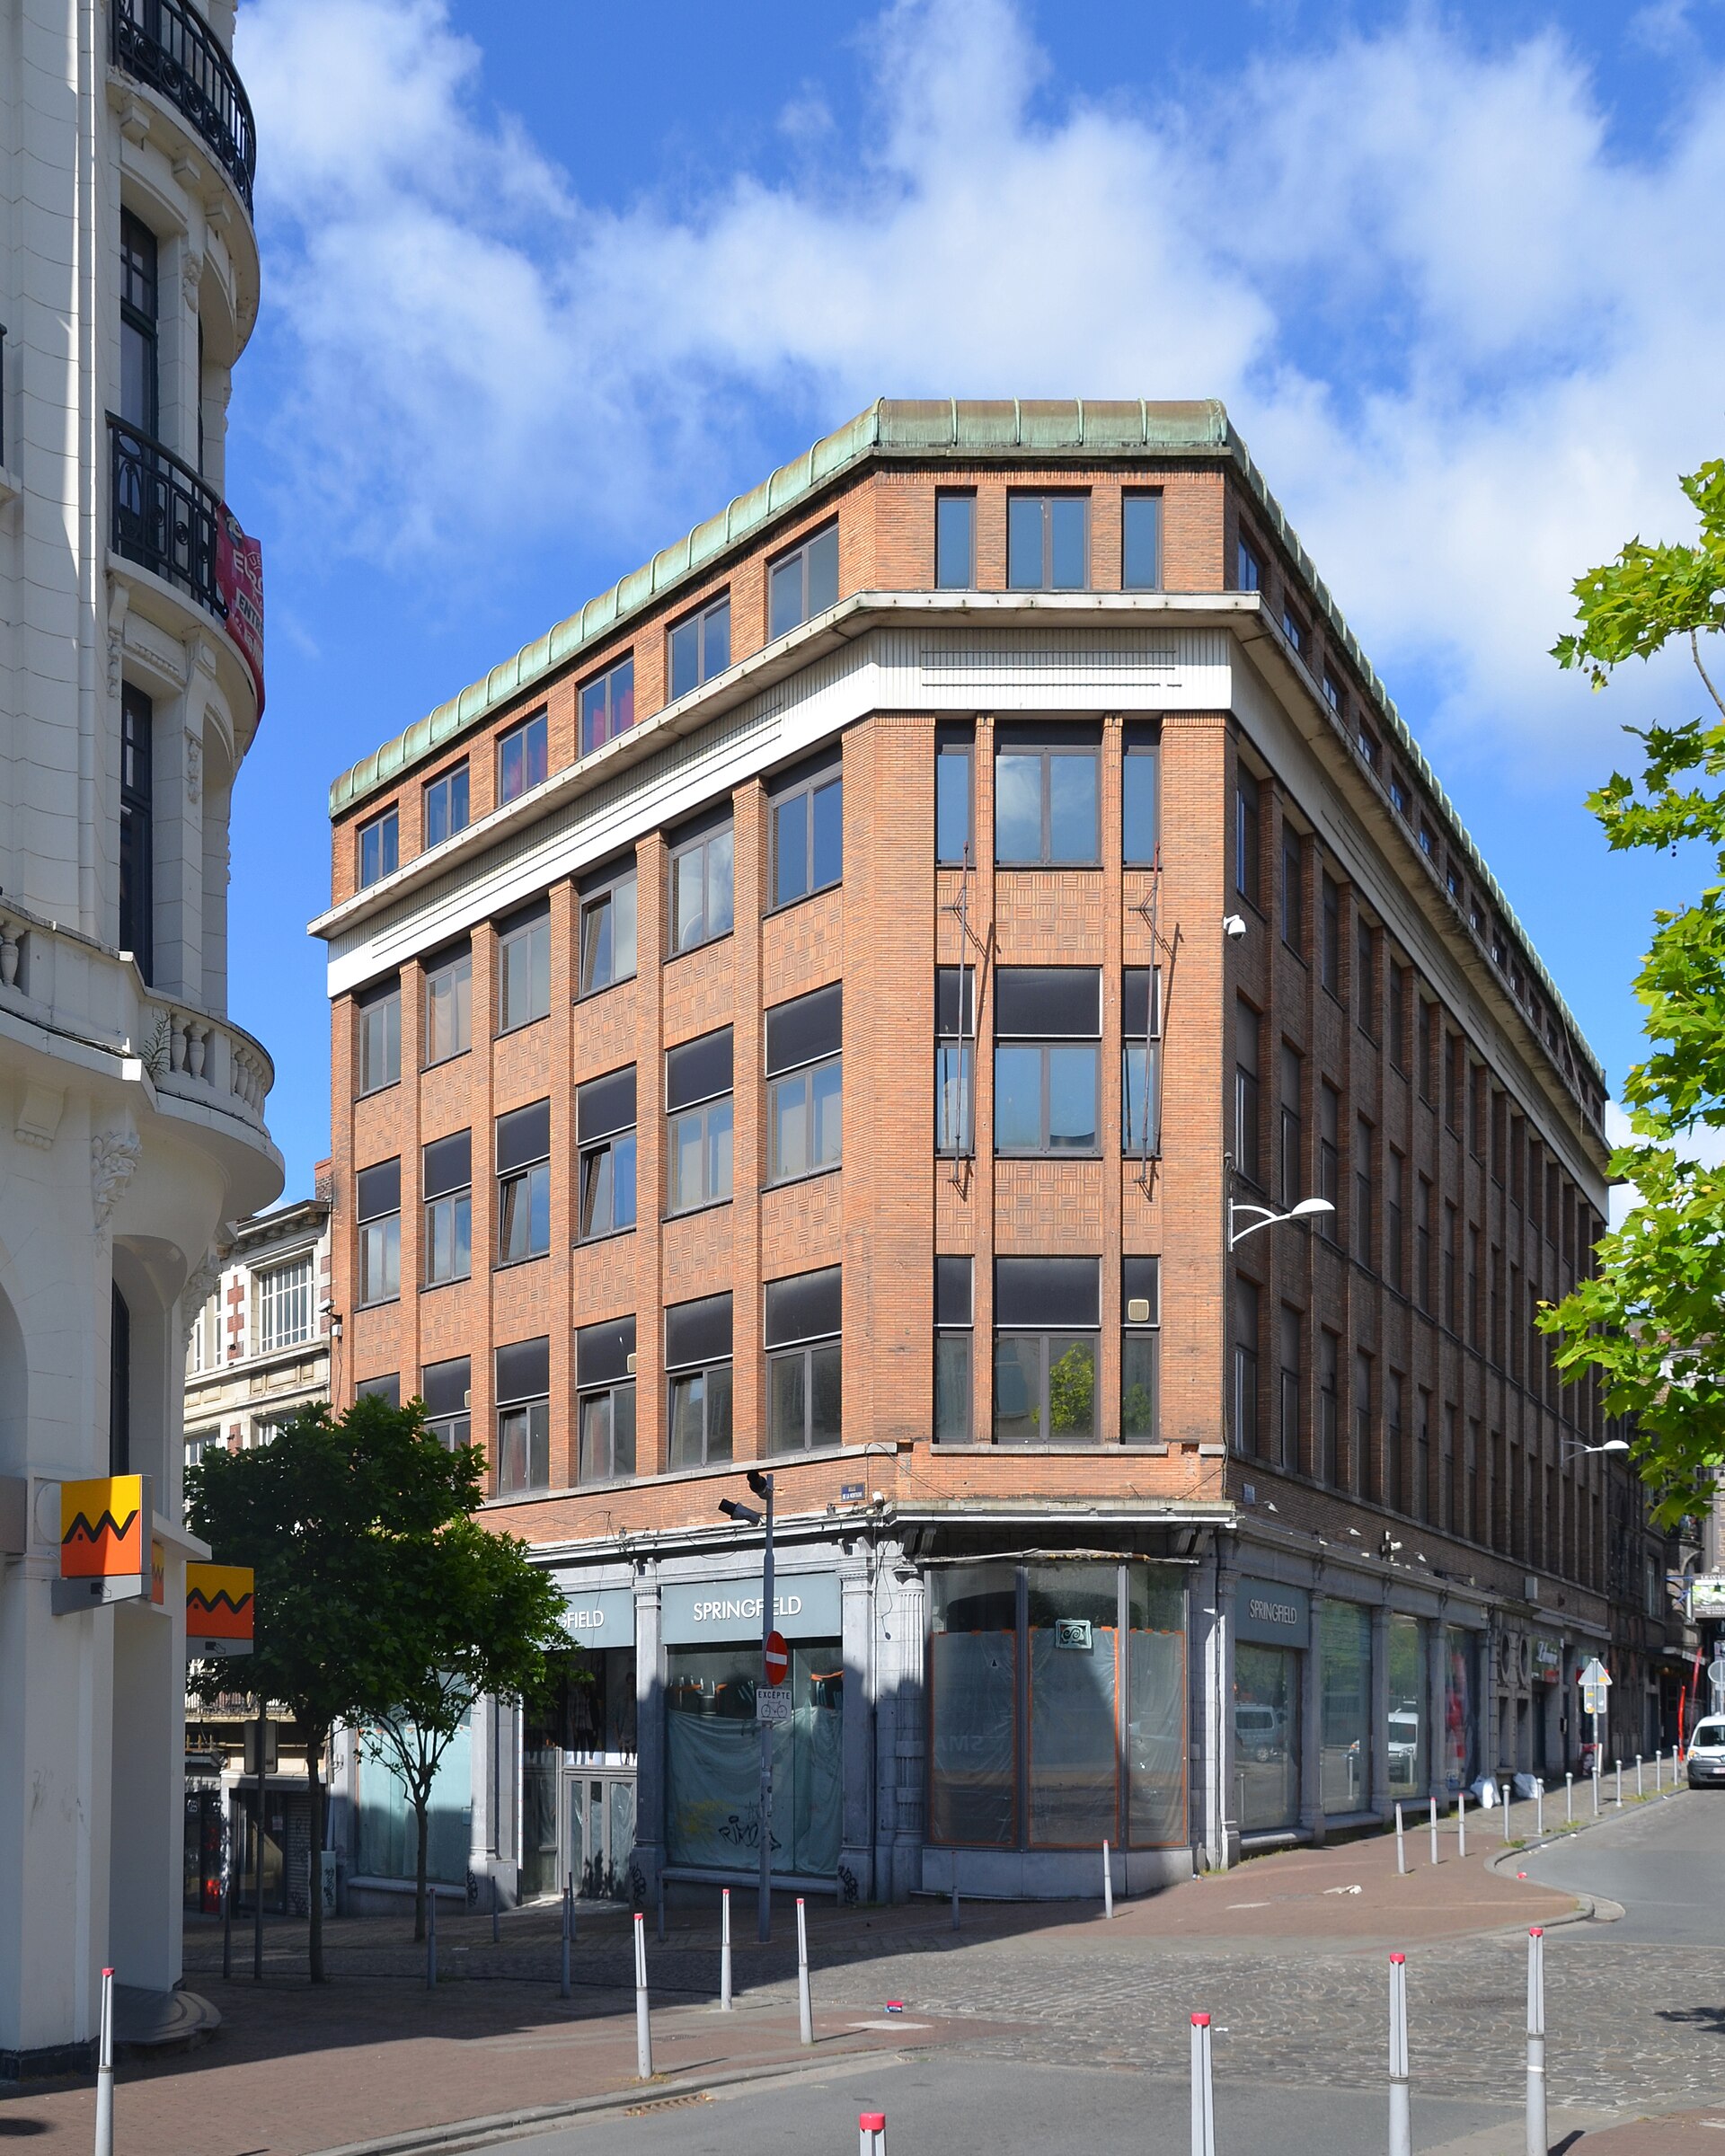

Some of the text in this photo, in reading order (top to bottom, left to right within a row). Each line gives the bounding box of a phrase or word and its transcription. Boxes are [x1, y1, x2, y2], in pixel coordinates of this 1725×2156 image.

[555, 1611, 605, 1630] GFIELD
[693, 1595, 802, 1621] SPRINGFELD
[1250, 1599, 1297, 1624] SPRINGFIELD
